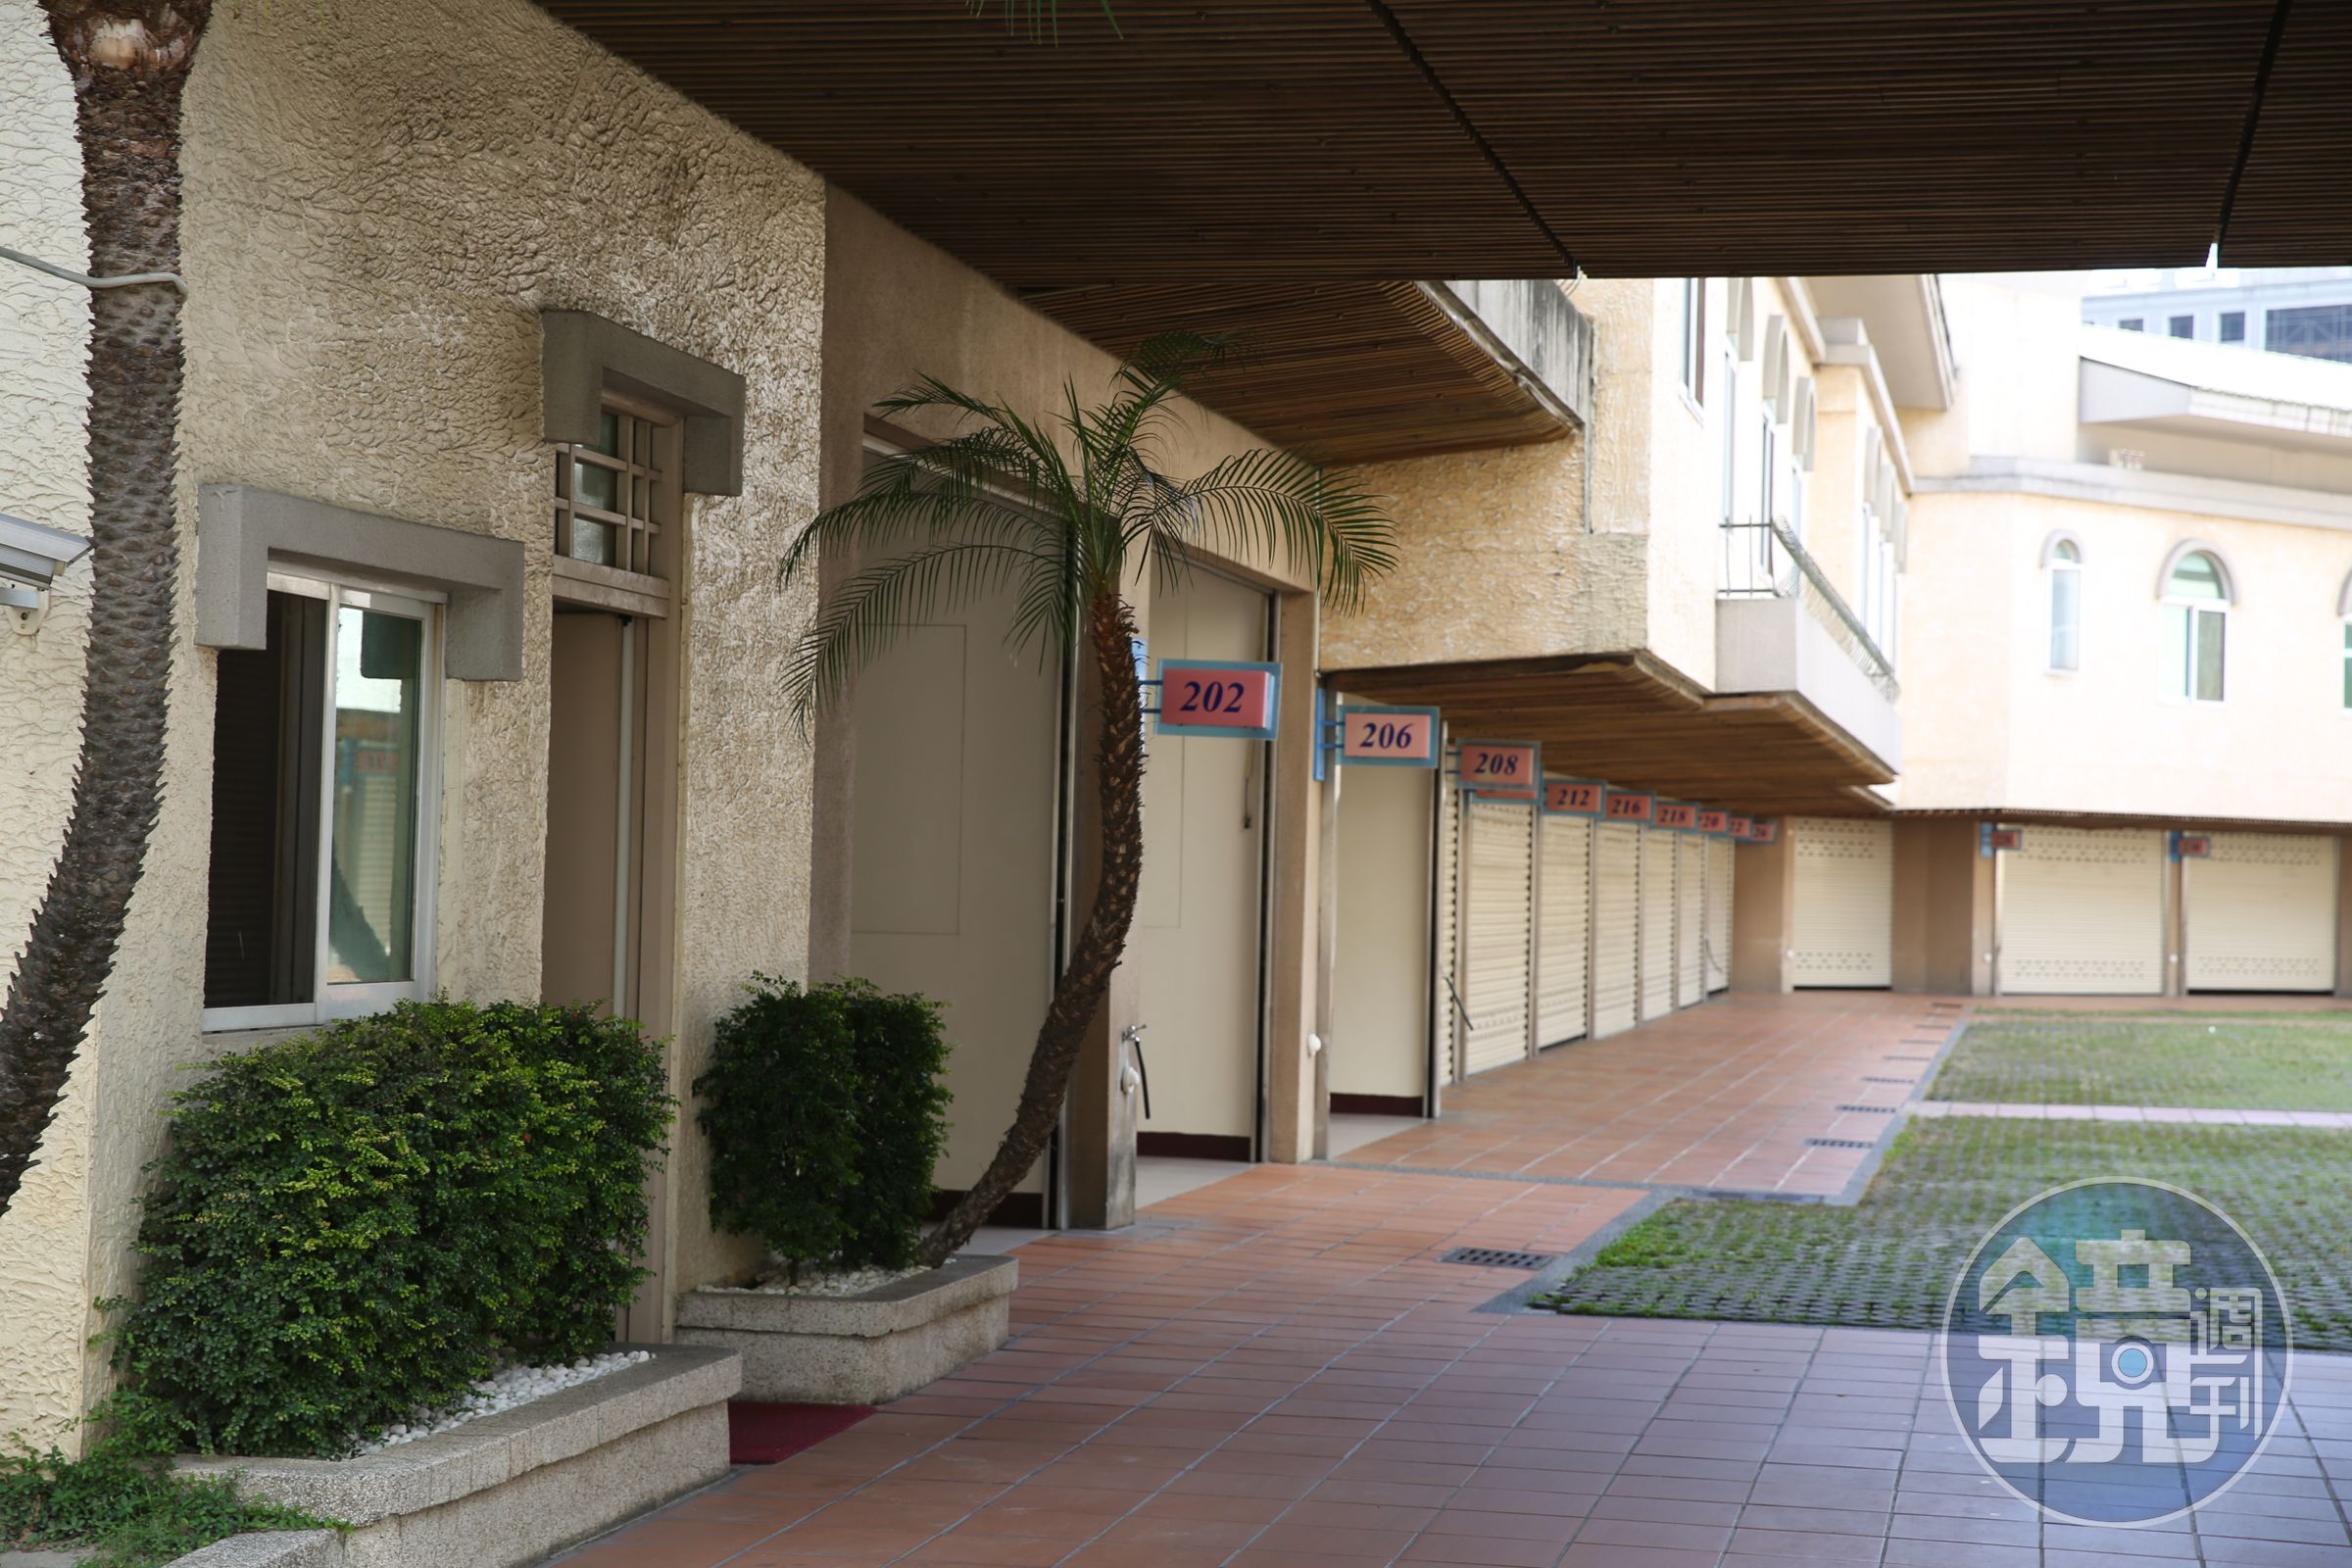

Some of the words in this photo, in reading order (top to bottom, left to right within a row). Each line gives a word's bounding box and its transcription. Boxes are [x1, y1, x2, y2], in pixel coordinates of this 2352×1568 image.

[1179, 680, 1245, 713] 202
[1359, 722, 1414, 749] 206
[1473, 752, 1519, 776] 208
[1555, 789, 1591, 807] 212
[1611, 798, 1642, 814] 216
